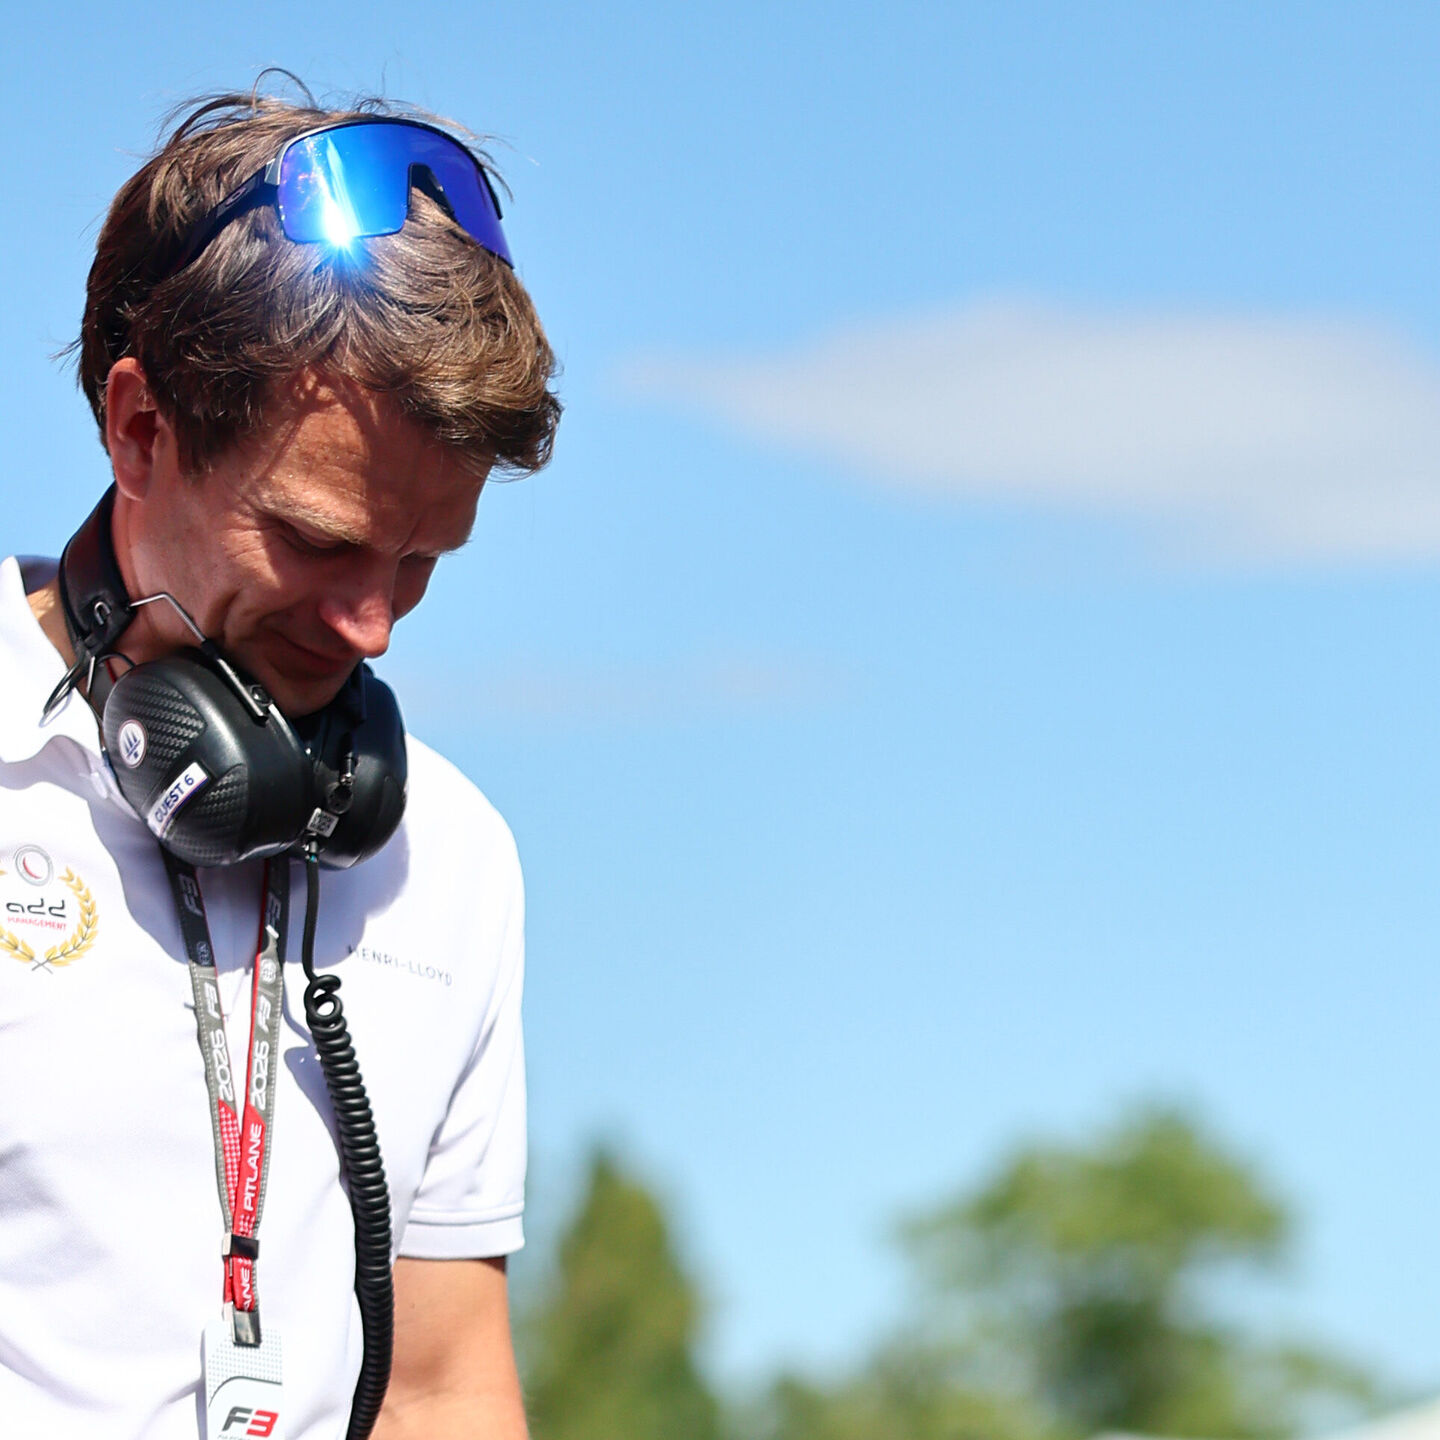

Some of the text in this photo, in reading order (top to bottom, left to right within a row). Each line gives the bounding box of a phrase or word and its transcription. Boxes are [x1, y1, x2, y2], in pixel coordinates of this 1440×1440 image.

[154, 773, 195, 823] GUEST 6
[210, 1028, 234, 1102] 2026
[250, 1039, 270, 1111] 2026
[243, 1122, 263, 1212] PITLANE
[222, 1405, 280, 1439] F3
